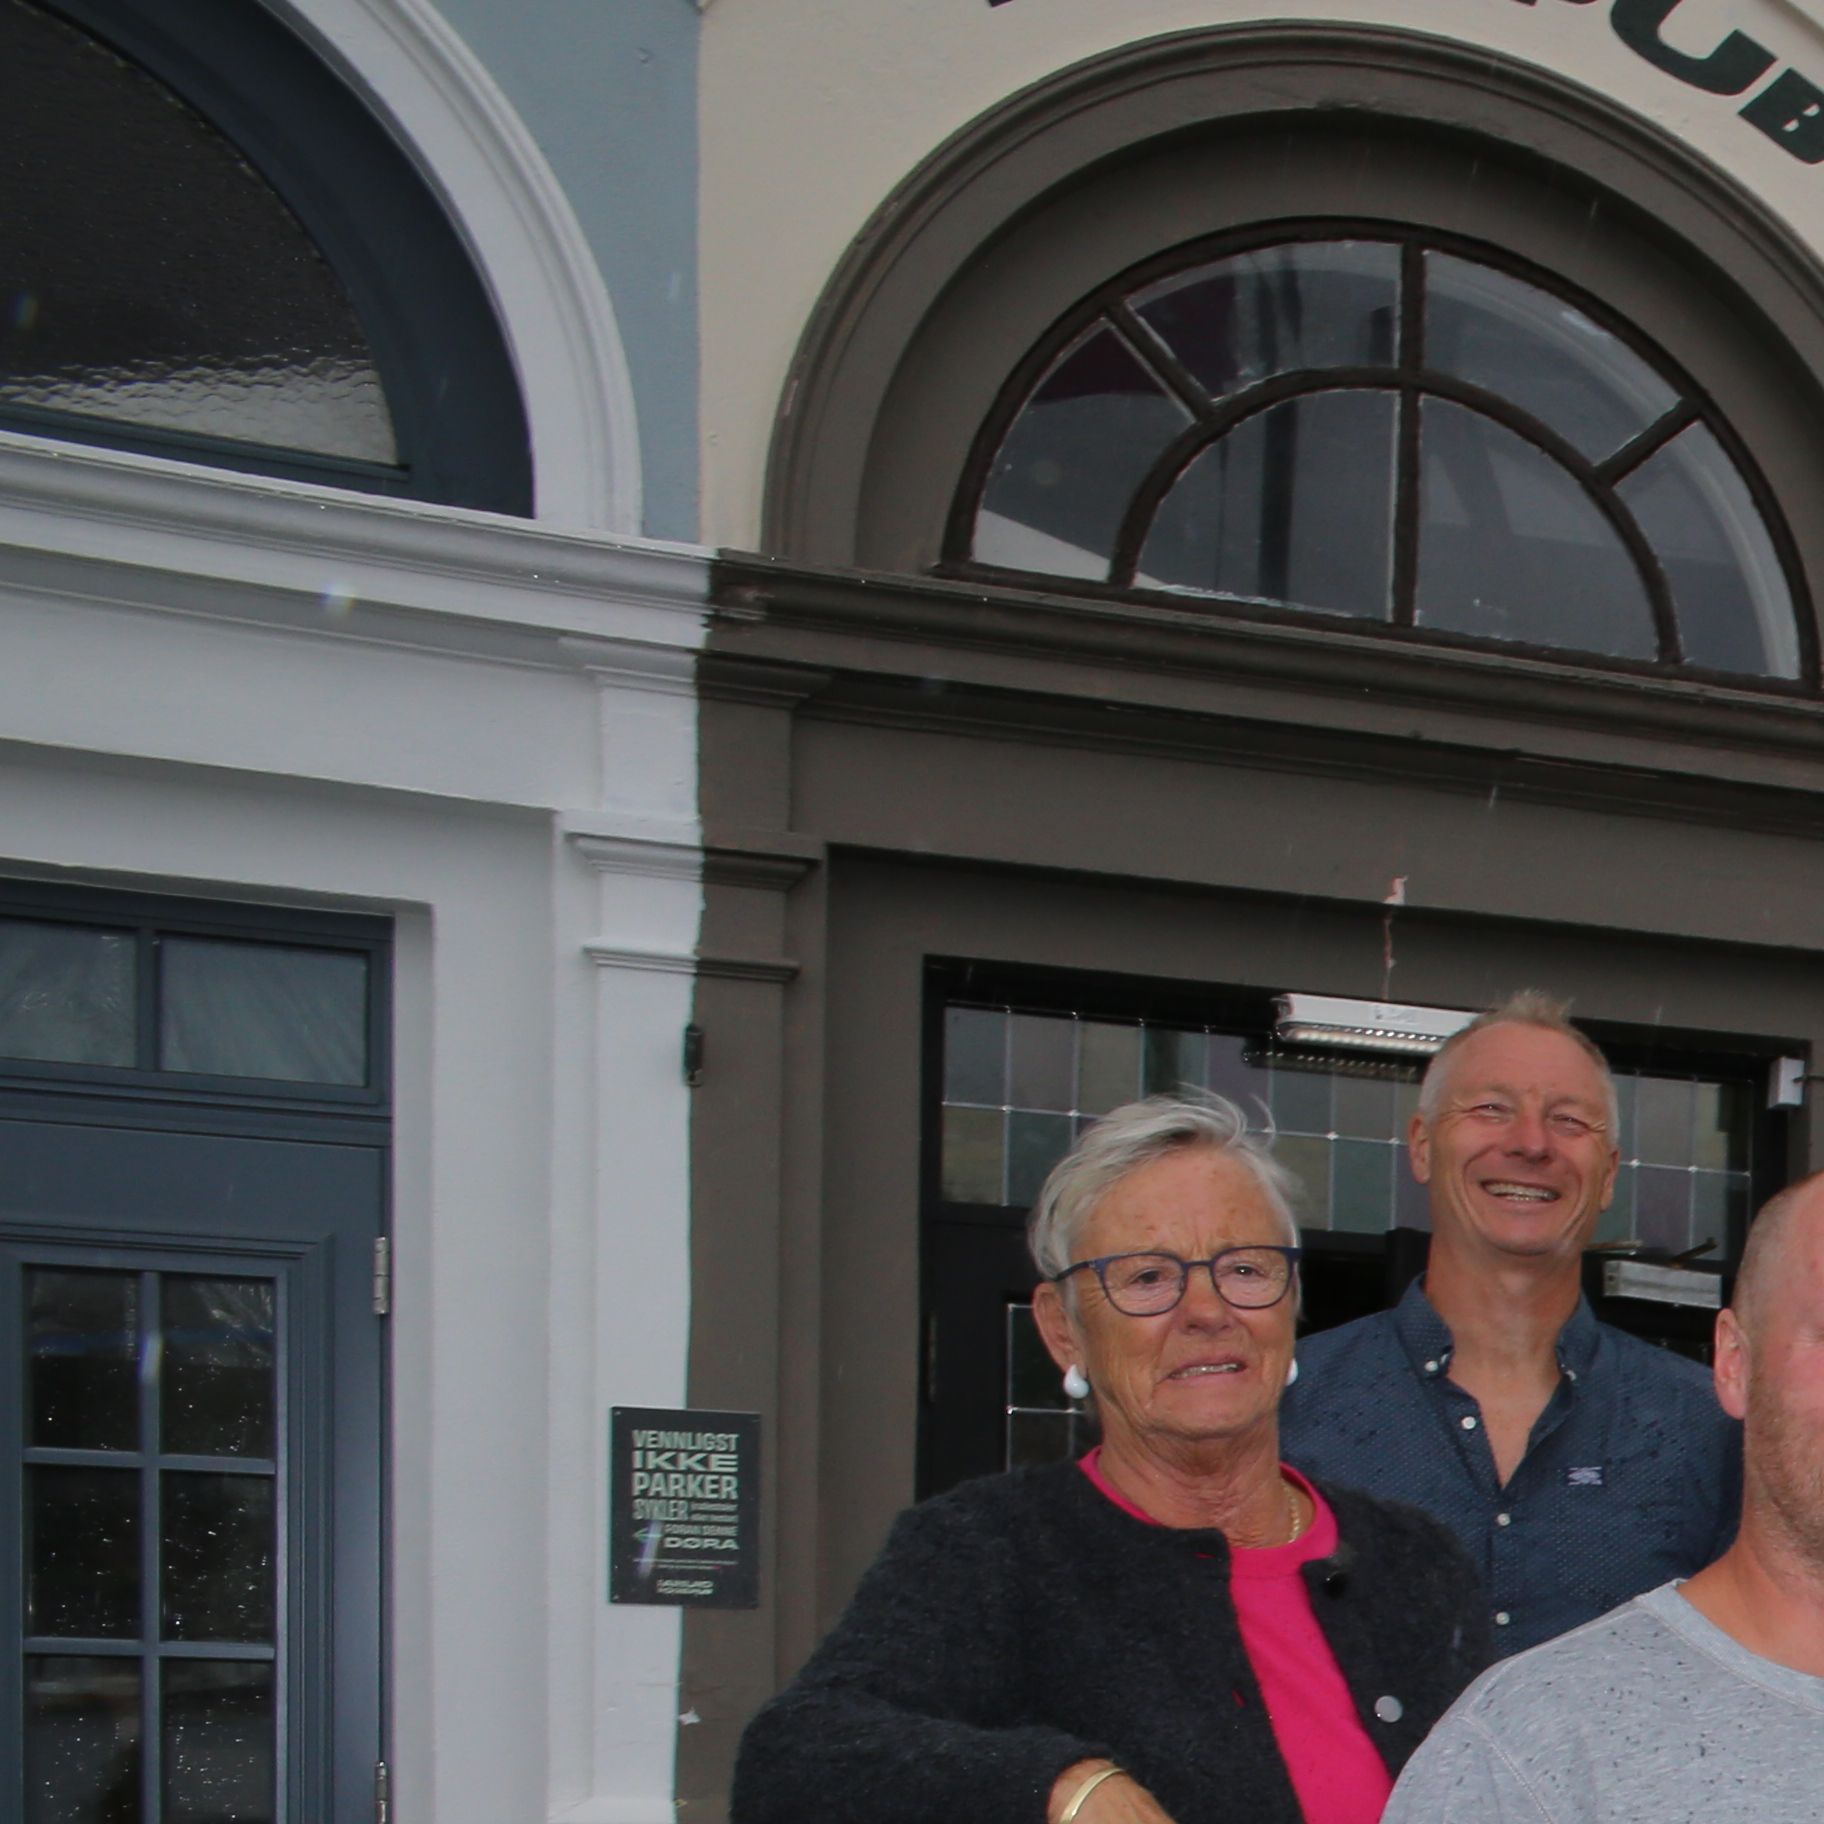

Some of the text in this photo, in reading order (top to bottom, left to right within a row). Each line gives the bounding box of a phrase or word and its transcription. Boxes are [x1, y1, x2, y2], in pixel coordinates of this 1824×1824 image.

[632, 1429, 740, 1452] VENNLIGST
[633, 1450, 739, 1472] IKKE
[632, 1472, 739, 1500] PARKER
